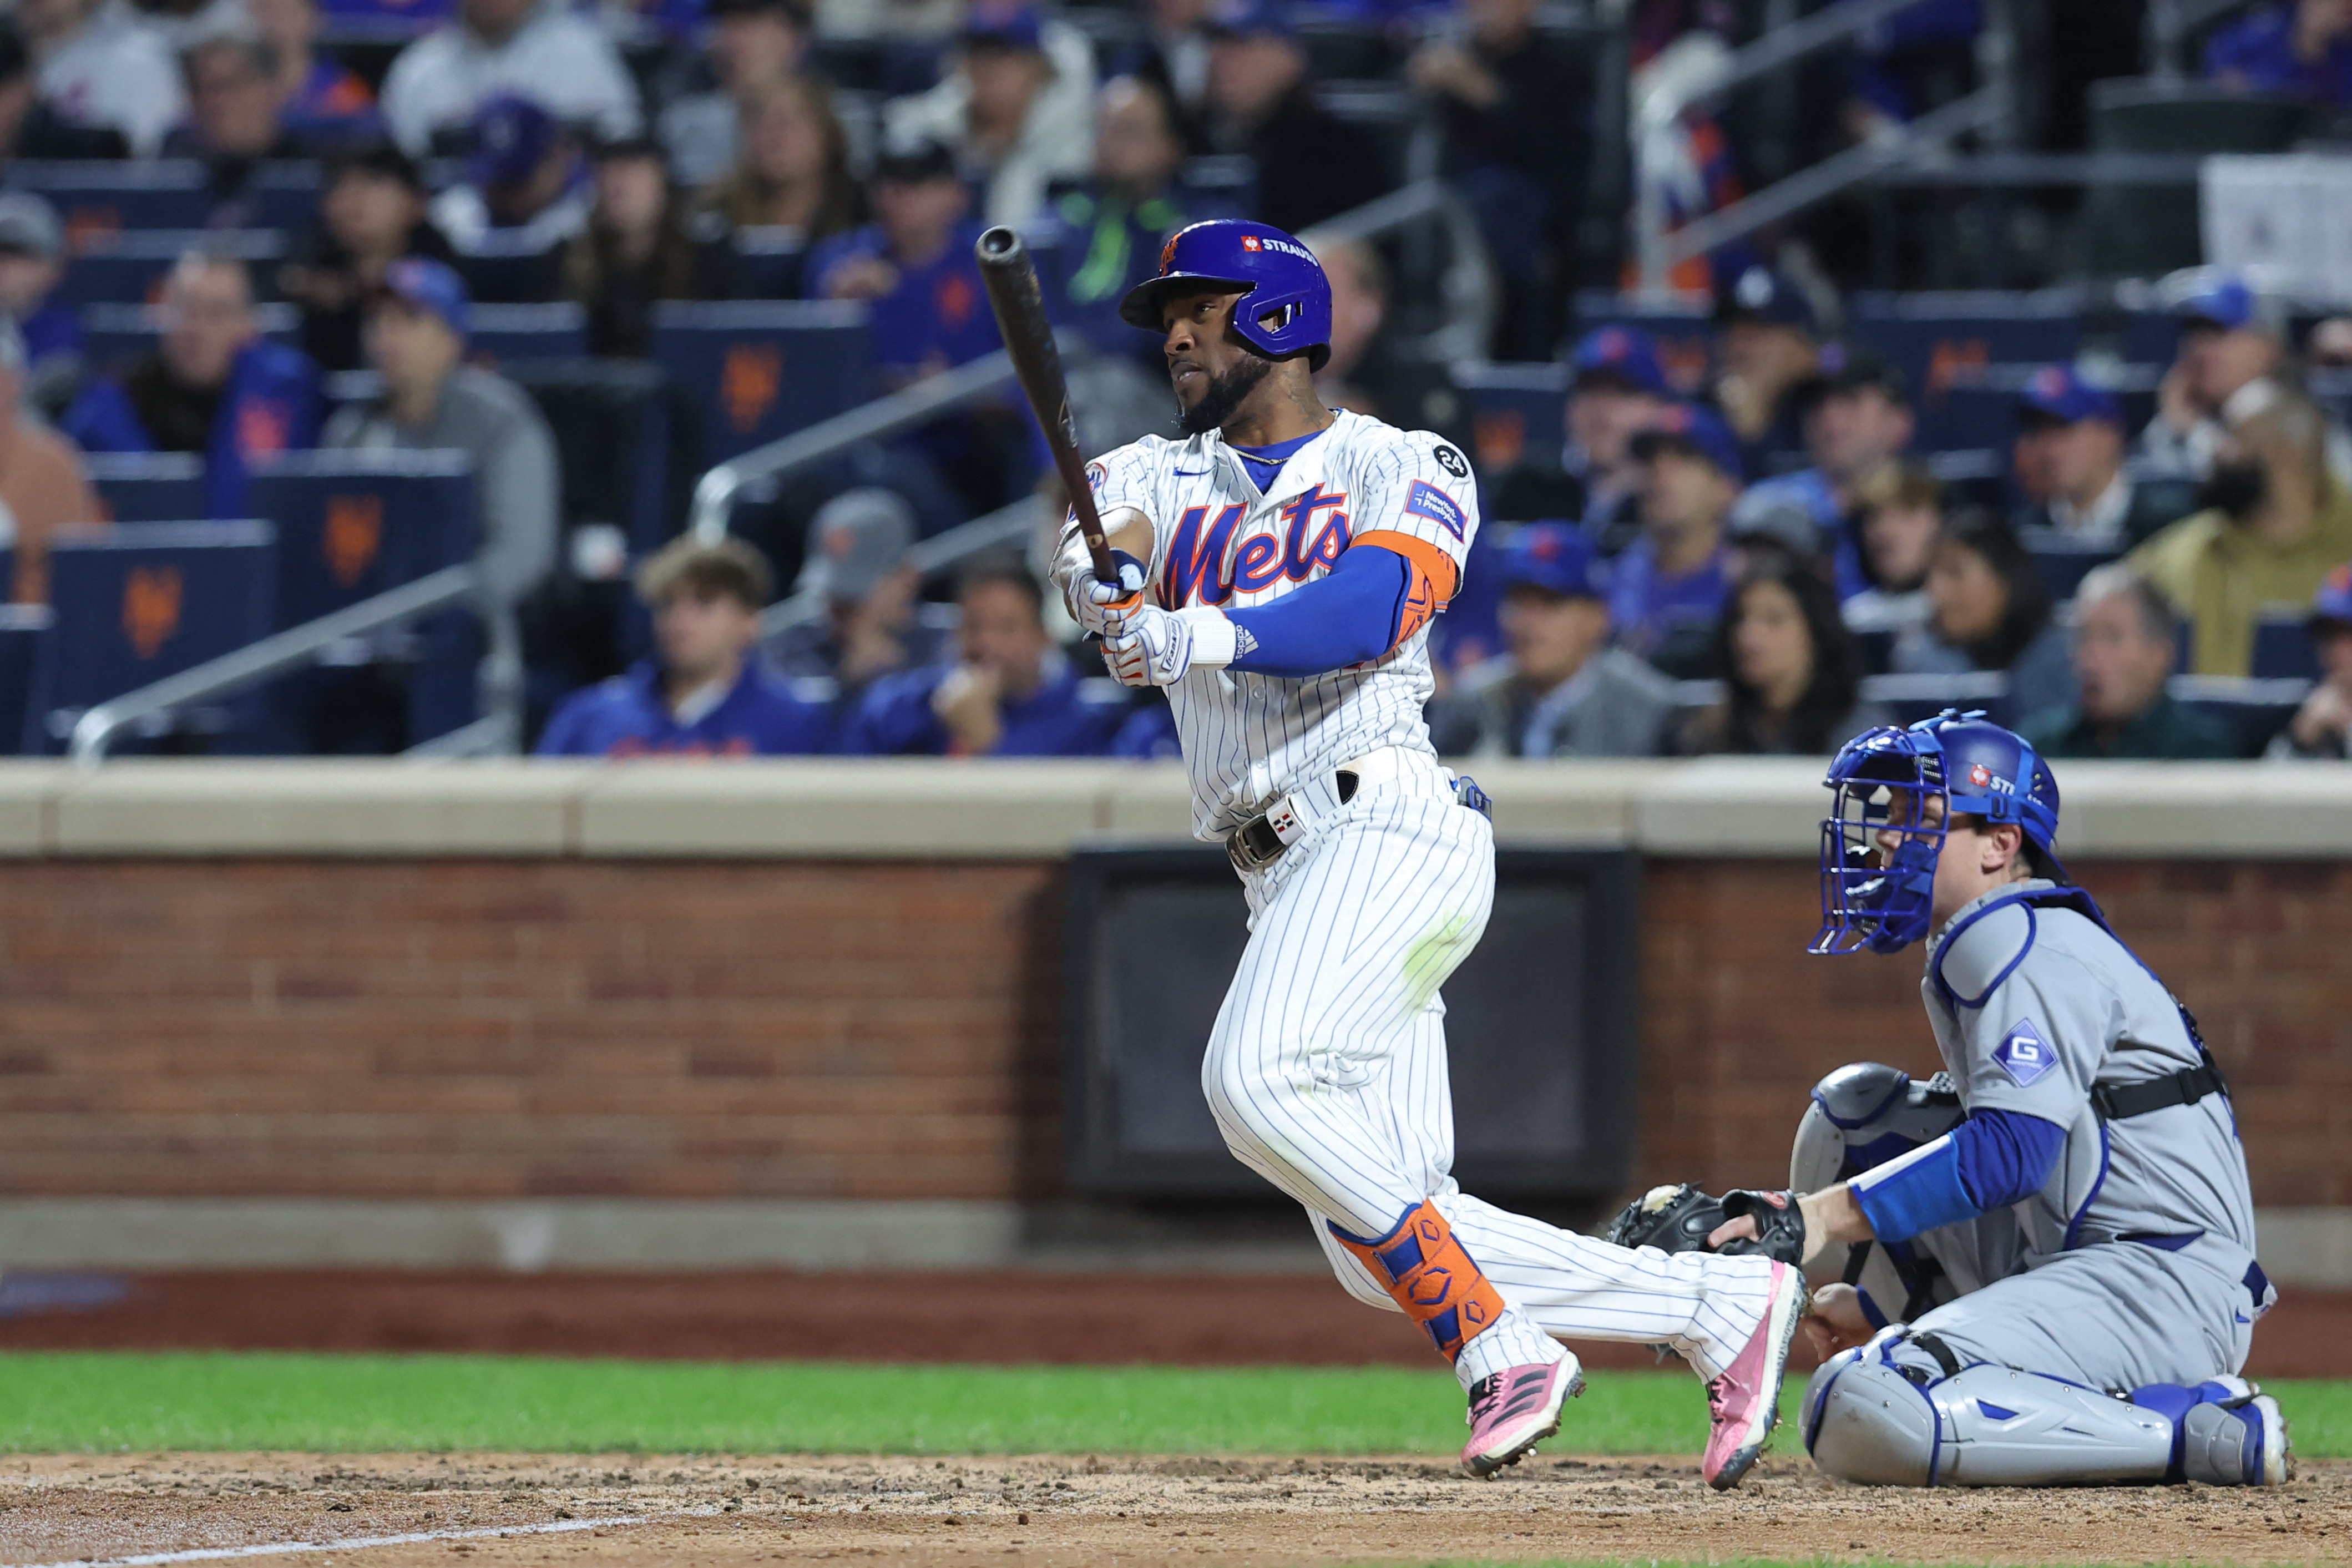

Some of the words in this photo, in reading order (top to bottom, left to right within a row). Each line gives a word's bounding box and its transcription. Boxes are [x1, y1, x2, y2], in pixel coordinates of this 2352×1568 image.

[1439, 451, 1464, 474] 24
[1423, 499, 1461, 535] Presbyterian
[1155, 482, 1352, 611] Mets
[1236, 625, 1245, 660] adidas
[2011, 1036, 2039, 1060] G
